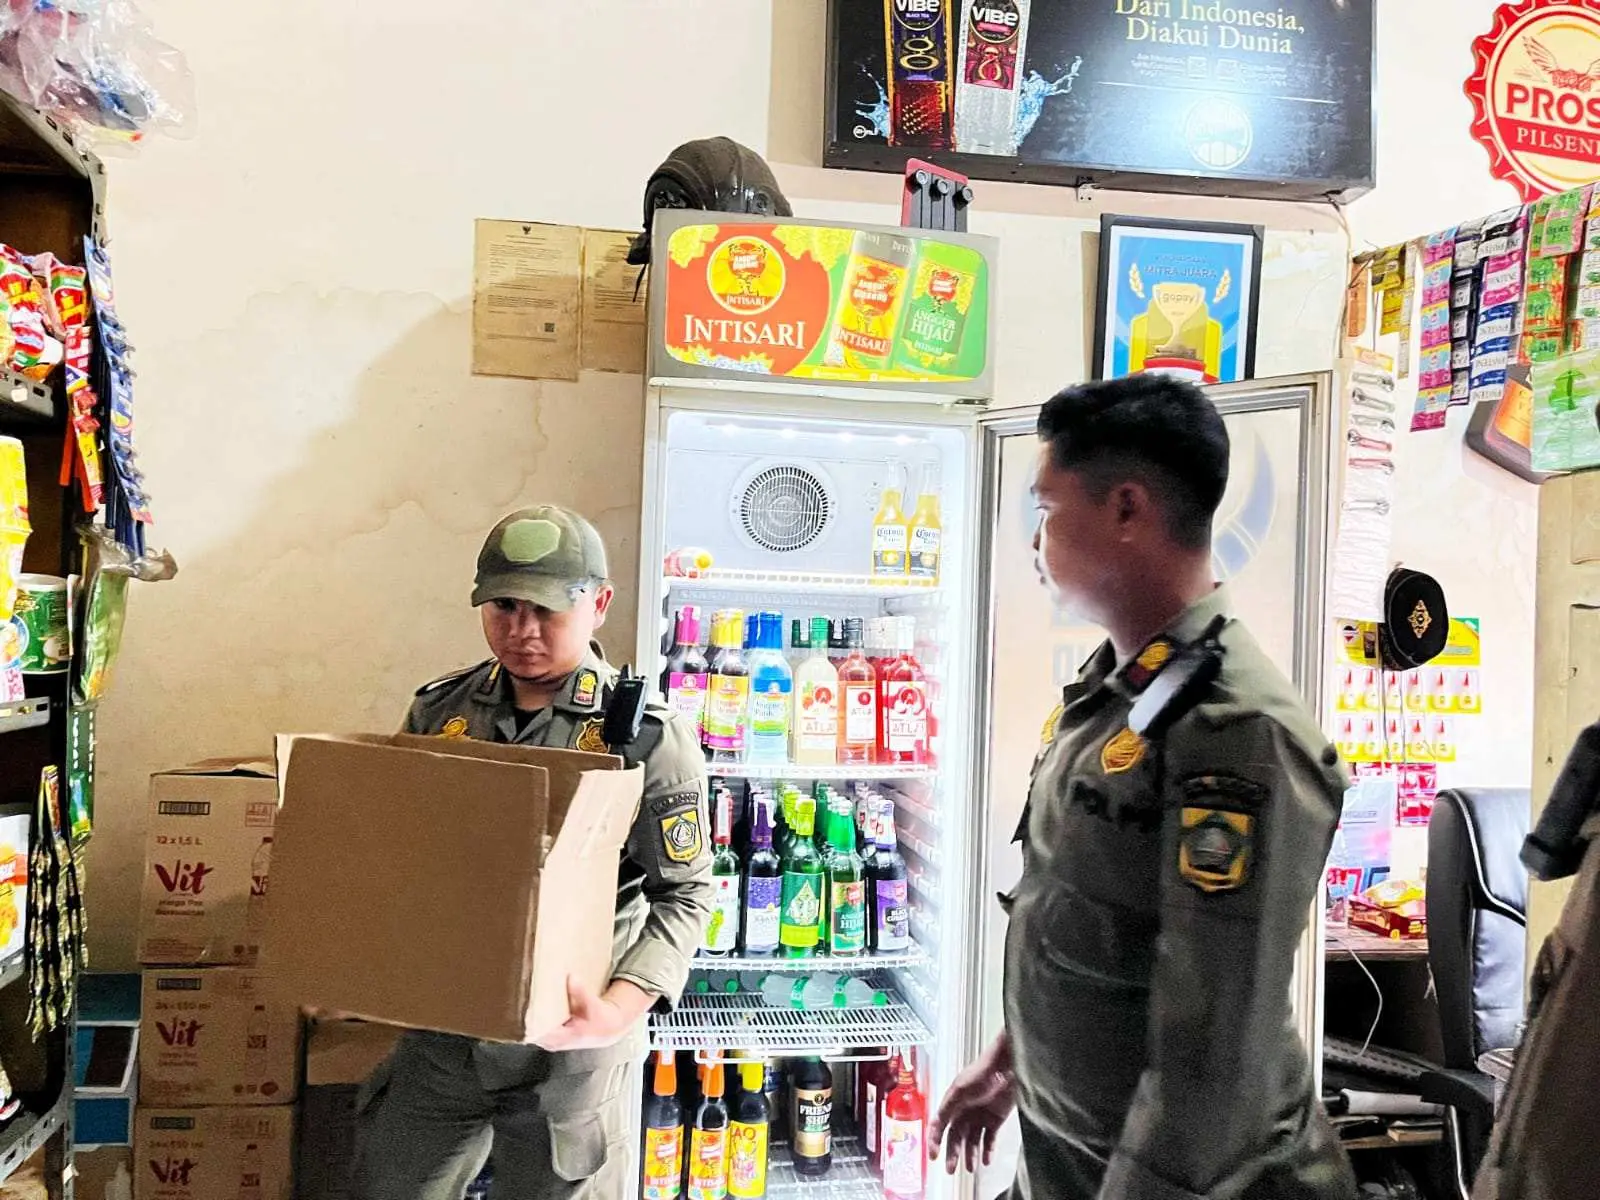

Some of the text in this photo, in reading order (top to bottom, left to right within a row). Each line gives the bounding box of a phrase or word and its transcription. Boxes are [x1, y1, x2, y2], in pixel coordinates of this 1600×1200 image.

[1115, 0, 1305, 34] Dari Indonesia,
[1126, 17, 1292, 54] Diakui Dunia
[683, 314, 806, 350] INTISARI
[910, 317, 955, 342] HIJAU
[913, 308, 957, 330] ANGGUR
[154, 859, 214, 895] Vit
[155, 1016, 205, 1047] Vit
[150, 1155, 199, 1186] Vit
